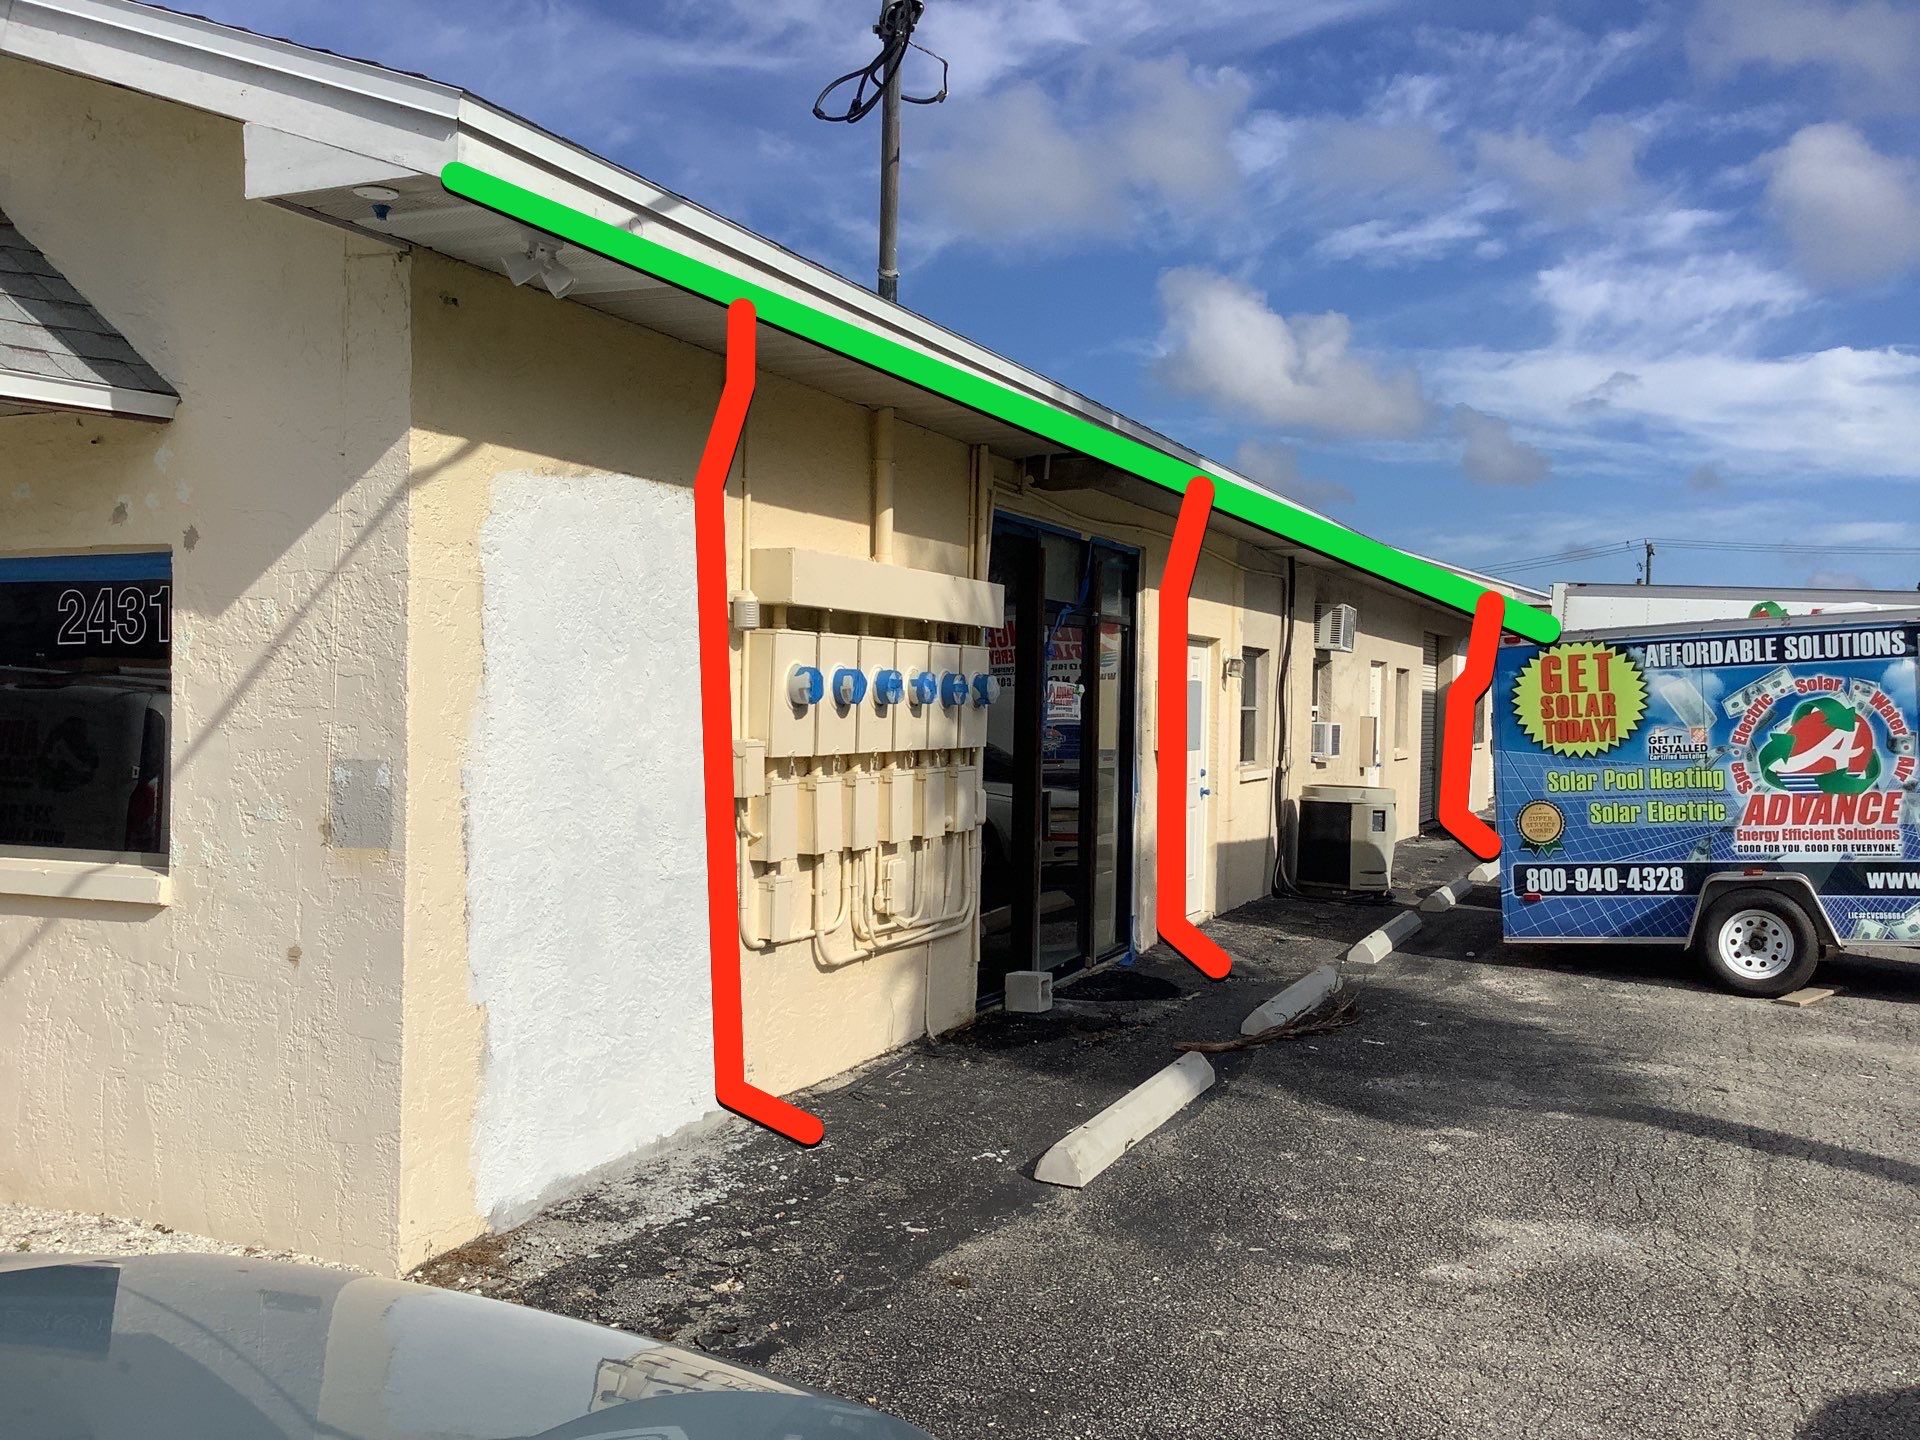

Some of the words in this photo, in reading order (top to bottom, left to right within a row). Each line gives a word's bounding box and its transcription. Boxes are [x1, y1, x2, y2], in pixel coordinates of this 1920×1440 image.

[57, 586, 171, 645] 2431
[1644, 637, 1778, 668] AFFORDABLE
[1784, 630, 1907, 661] SOLUTIONS
[1540, 653, 1614, 694] GET
[1540, 692, 1617, 719] SOLAR
[1543, 718, 1617, 745] TODAY!
[1648, 735, 1670, 745] GET
[1673, 735, 1683, 744] IT
[1731, 692, 1774, 746] Electric
[1794, 675, 1843, 695] Solar
[1869, 690, 1909, 736] Water
[1893, 756, 1916, 783] Air
[1648, 744, 1709, 754] INSTALLED
[1547, 771, 1599, 793] Solar
[1604, 768, 1645, 791] Pool
[1650, 766, 1726, 792] Heating
[1731, 762, 1754, 795] Spa
[1589, 802, 1642, 824] Solar
[1647, 799, 1727, 823] Electric
[1742, 791, 1903, 826] ADVANCE
[1736, 829, 1780, 843] Energy
[1782, 828, 1835, 841] Efficient
[1837, 828, 1900, 841] Solutions
[1764, 844, 1780, 853] FOR
[1783, 844, 1803, 853] YOU.
[1804, 844, 1829, 852] GOOD
[1832, 844, 1849, 852] FOR
[1526, 867, 1685, 892] 800-940-4328
